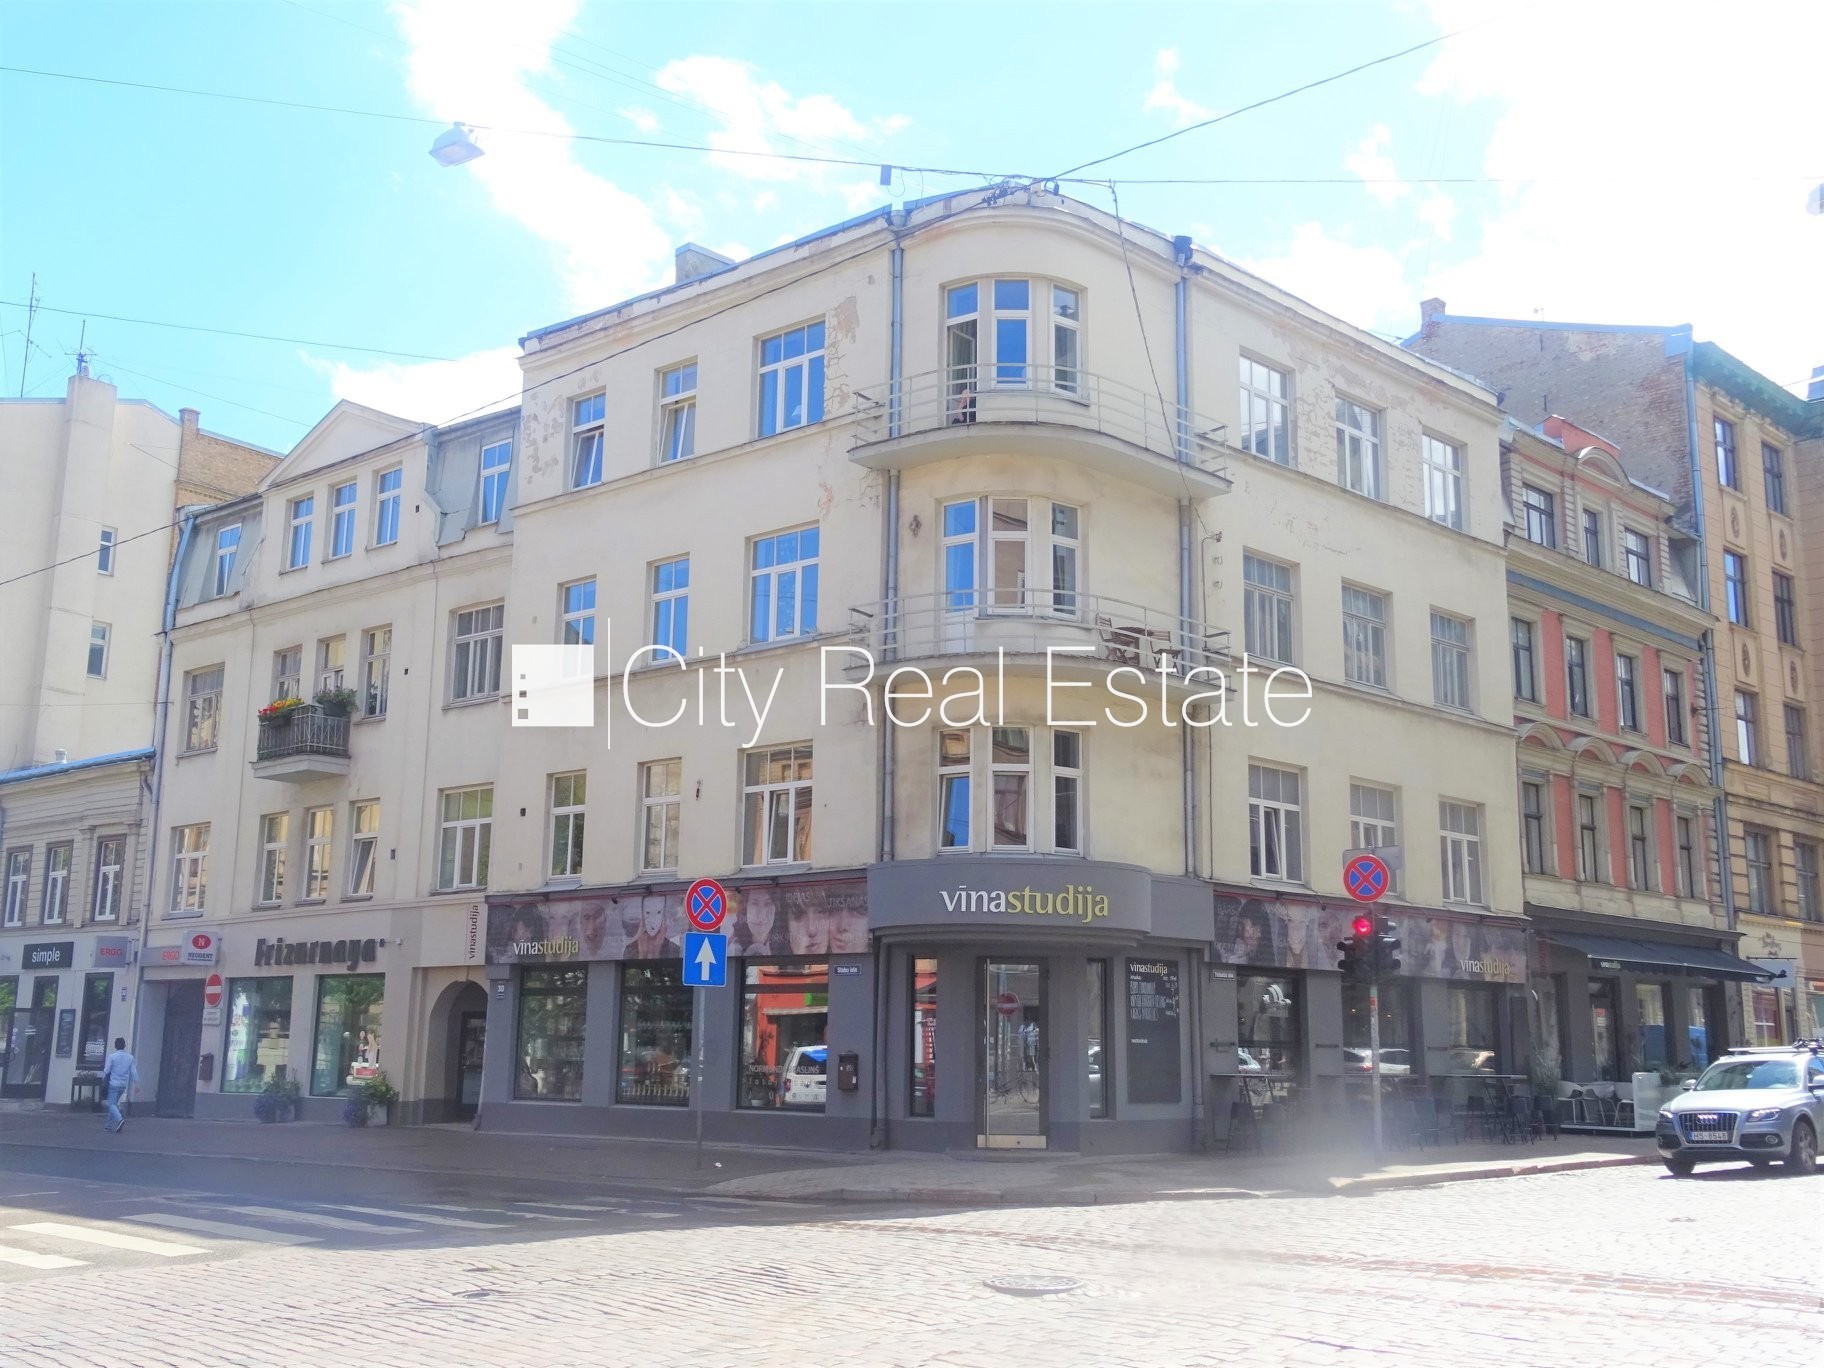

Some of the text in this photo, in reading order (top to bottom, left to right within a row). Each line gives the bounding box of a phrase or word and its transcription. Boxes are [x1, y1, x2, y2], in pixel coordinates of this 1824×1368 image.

[939, 885, 1108, 923] vīnastudija
[31, 947, 60, 963] simple
[100, 948, 123, 957] ERGO
